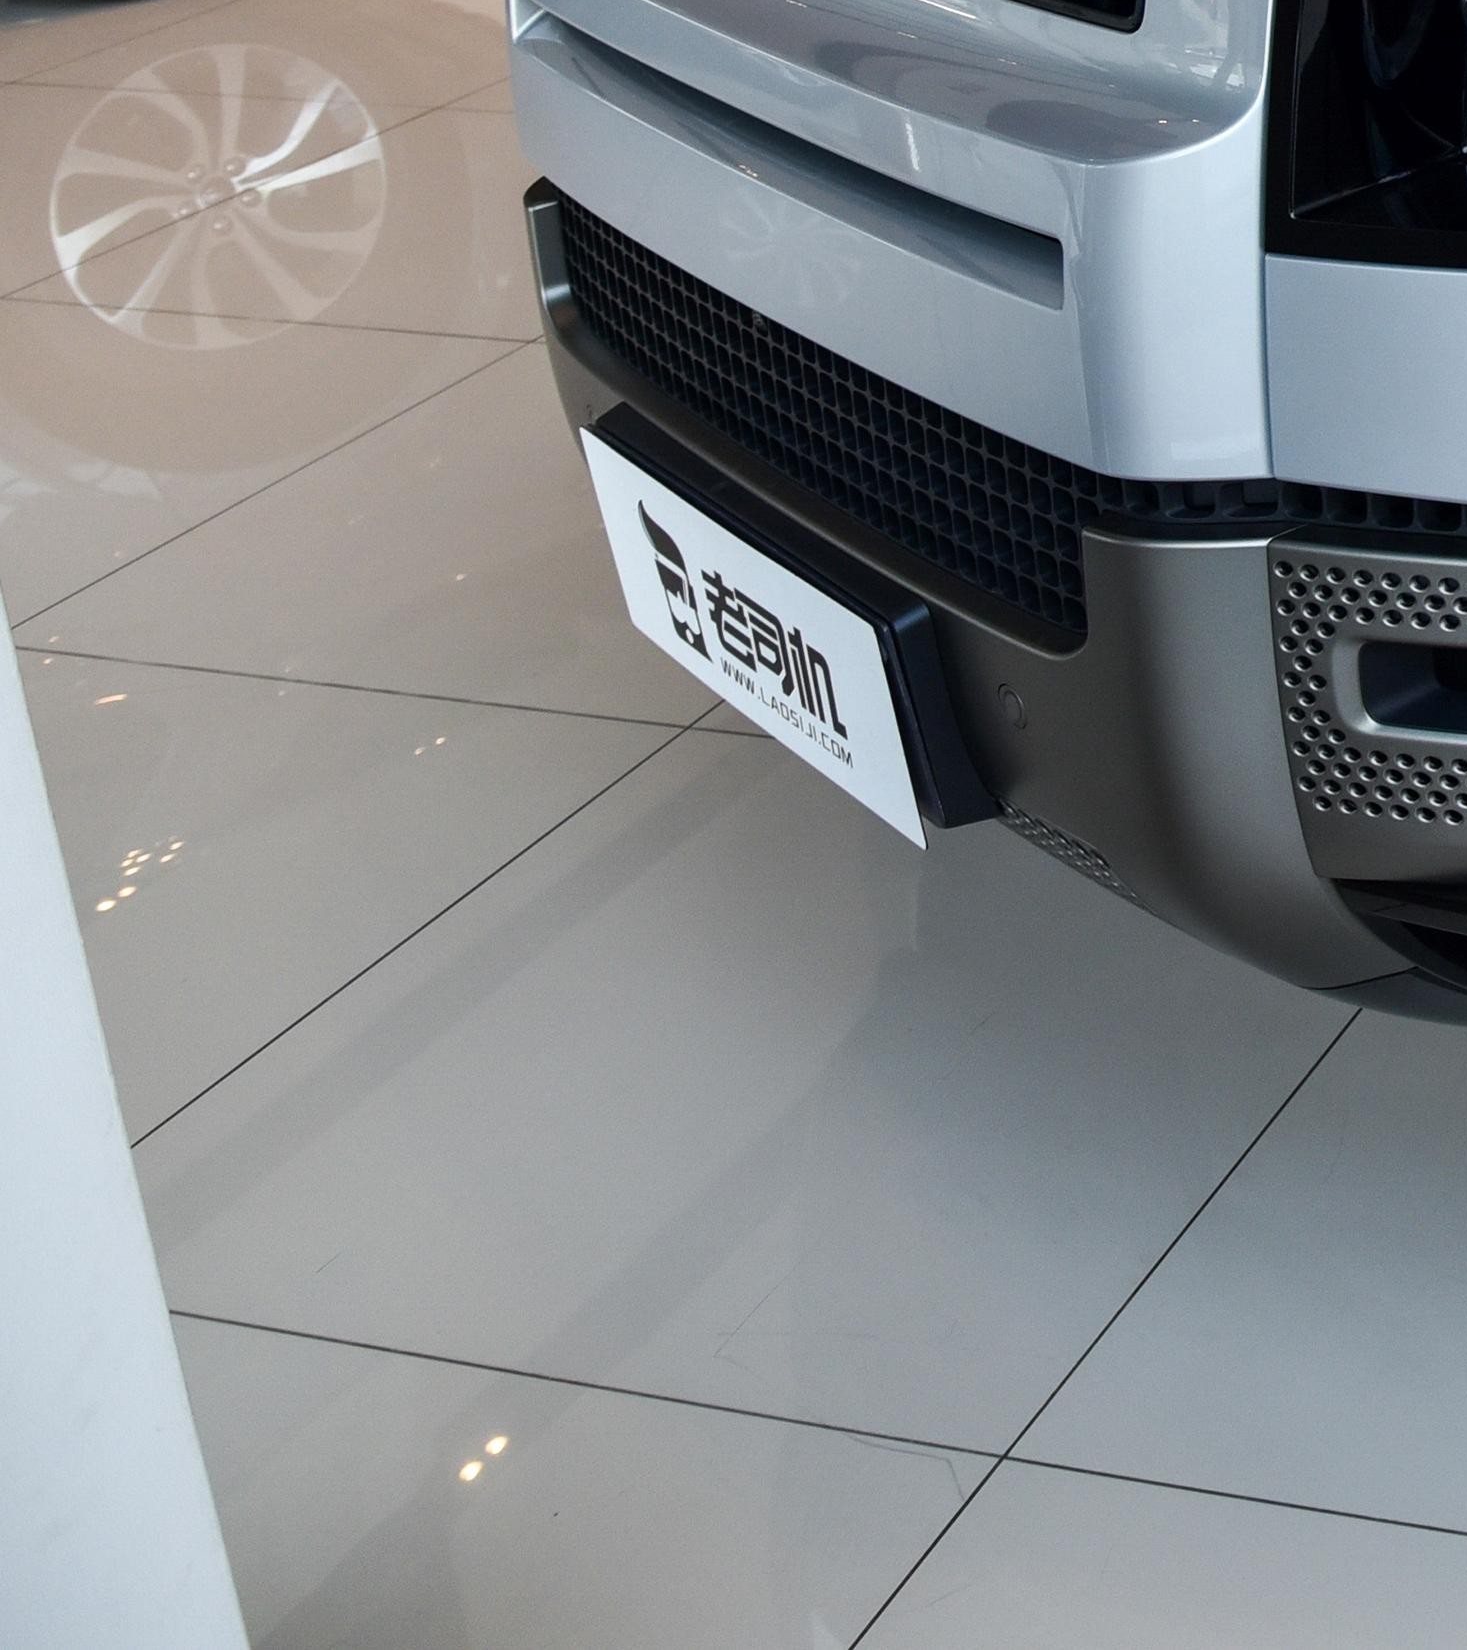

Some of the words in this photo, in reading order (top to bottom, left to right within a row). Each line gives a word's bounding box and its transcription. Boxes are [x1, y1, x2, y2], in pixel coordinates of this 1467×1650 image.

[700, 570, 848, 740] 老司机
[720, 657, 854, 769] WWW.LAOSIJI.COM
